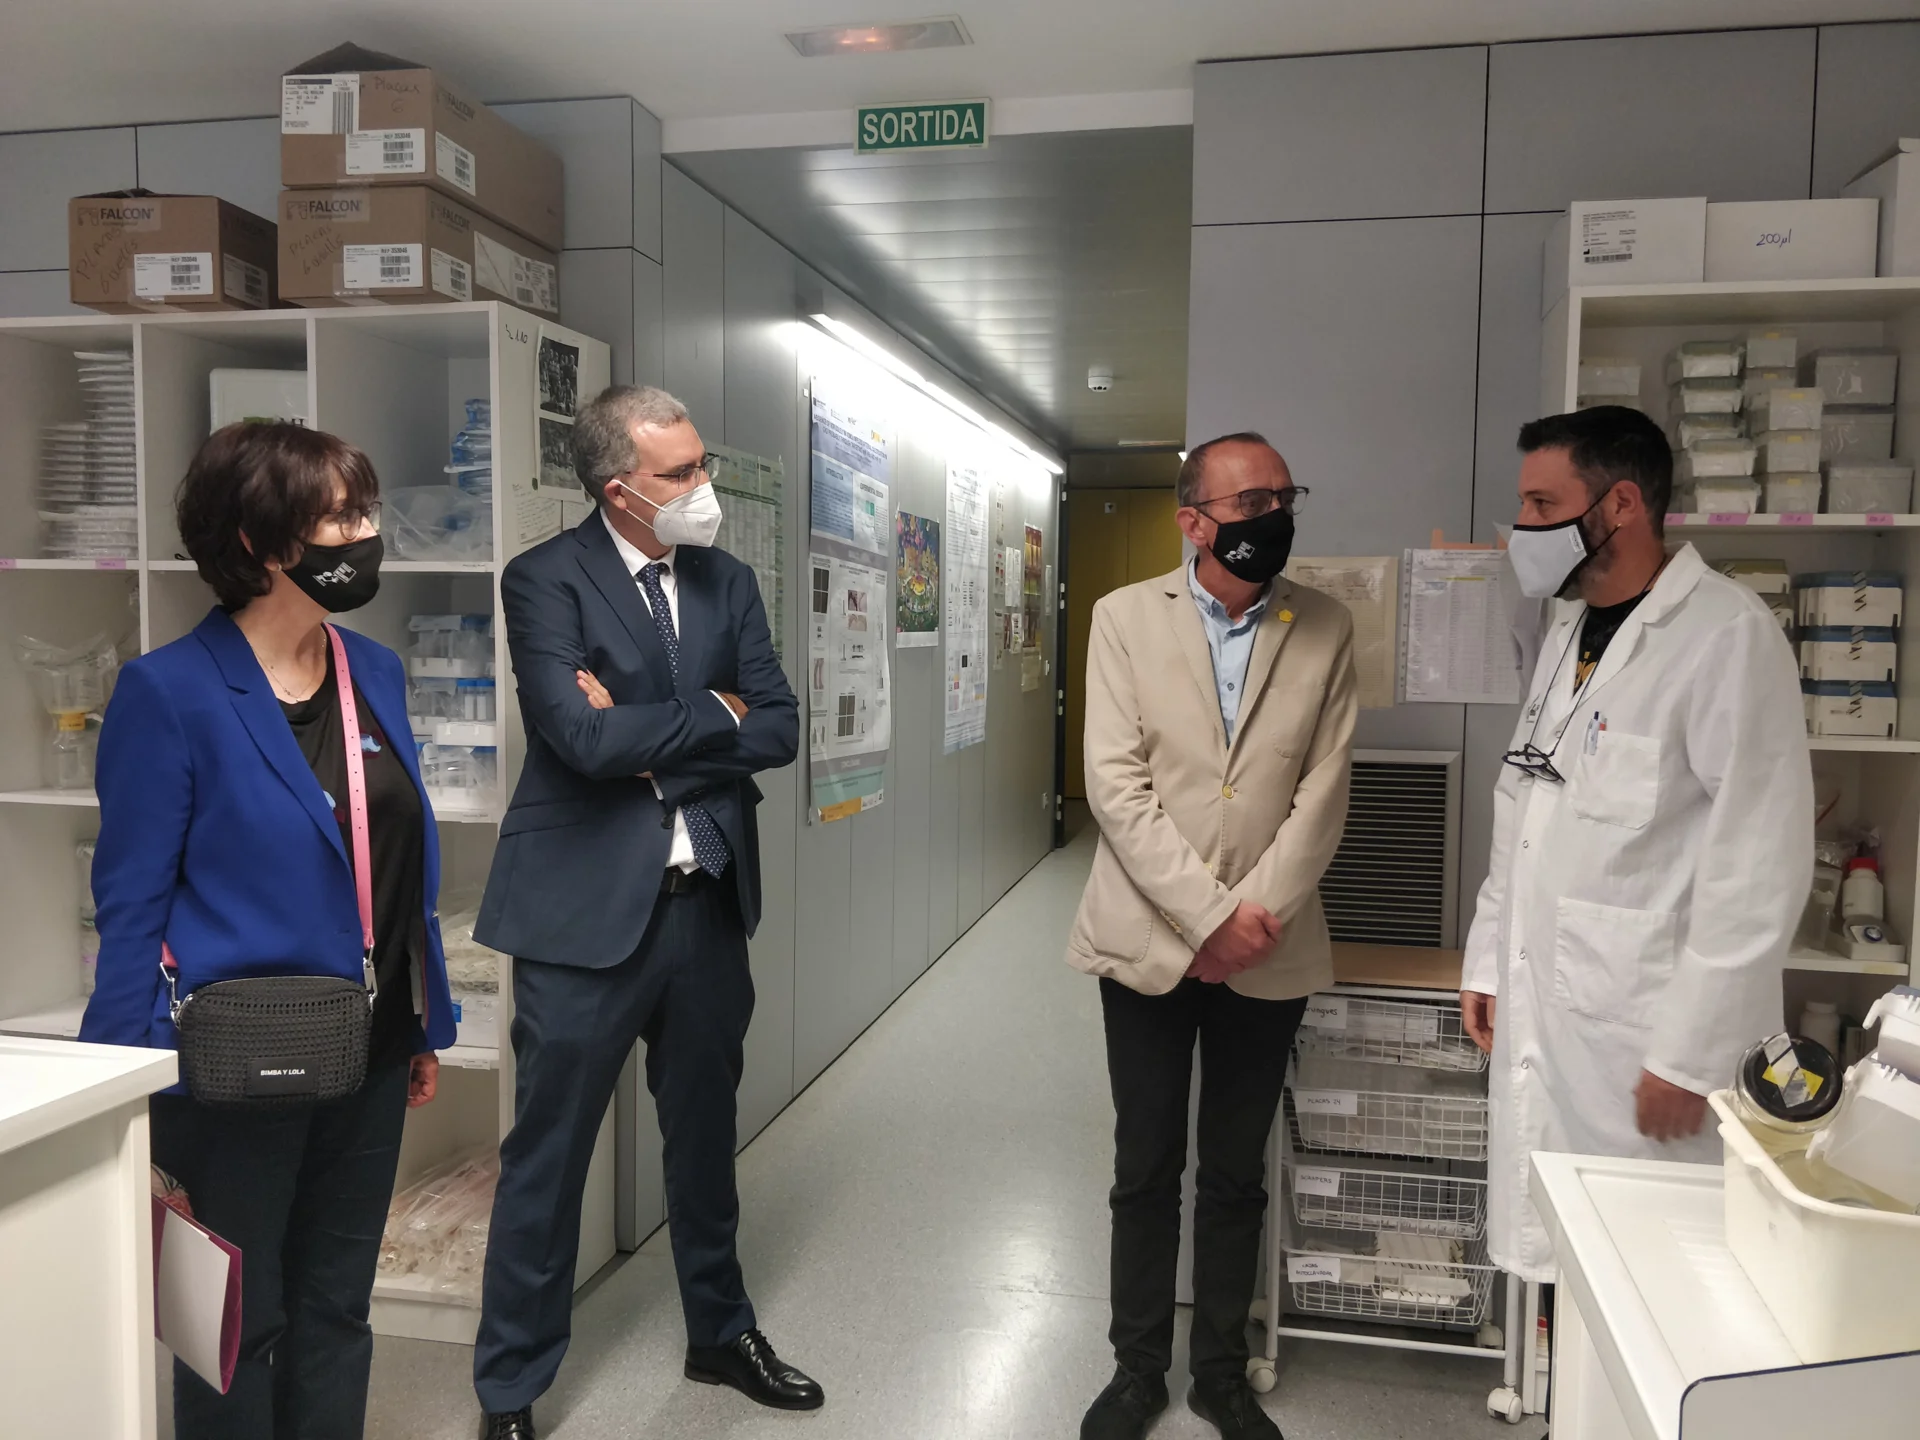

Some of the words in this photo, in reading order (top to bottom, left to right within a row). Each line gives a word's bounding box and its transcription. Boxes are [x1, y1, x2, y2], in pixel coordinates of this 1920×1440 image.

[863, 108, 979, 145] SORTIDA
[309, 200, 360, 213] FALCON
[100, 207, 151, 220] FALCON
